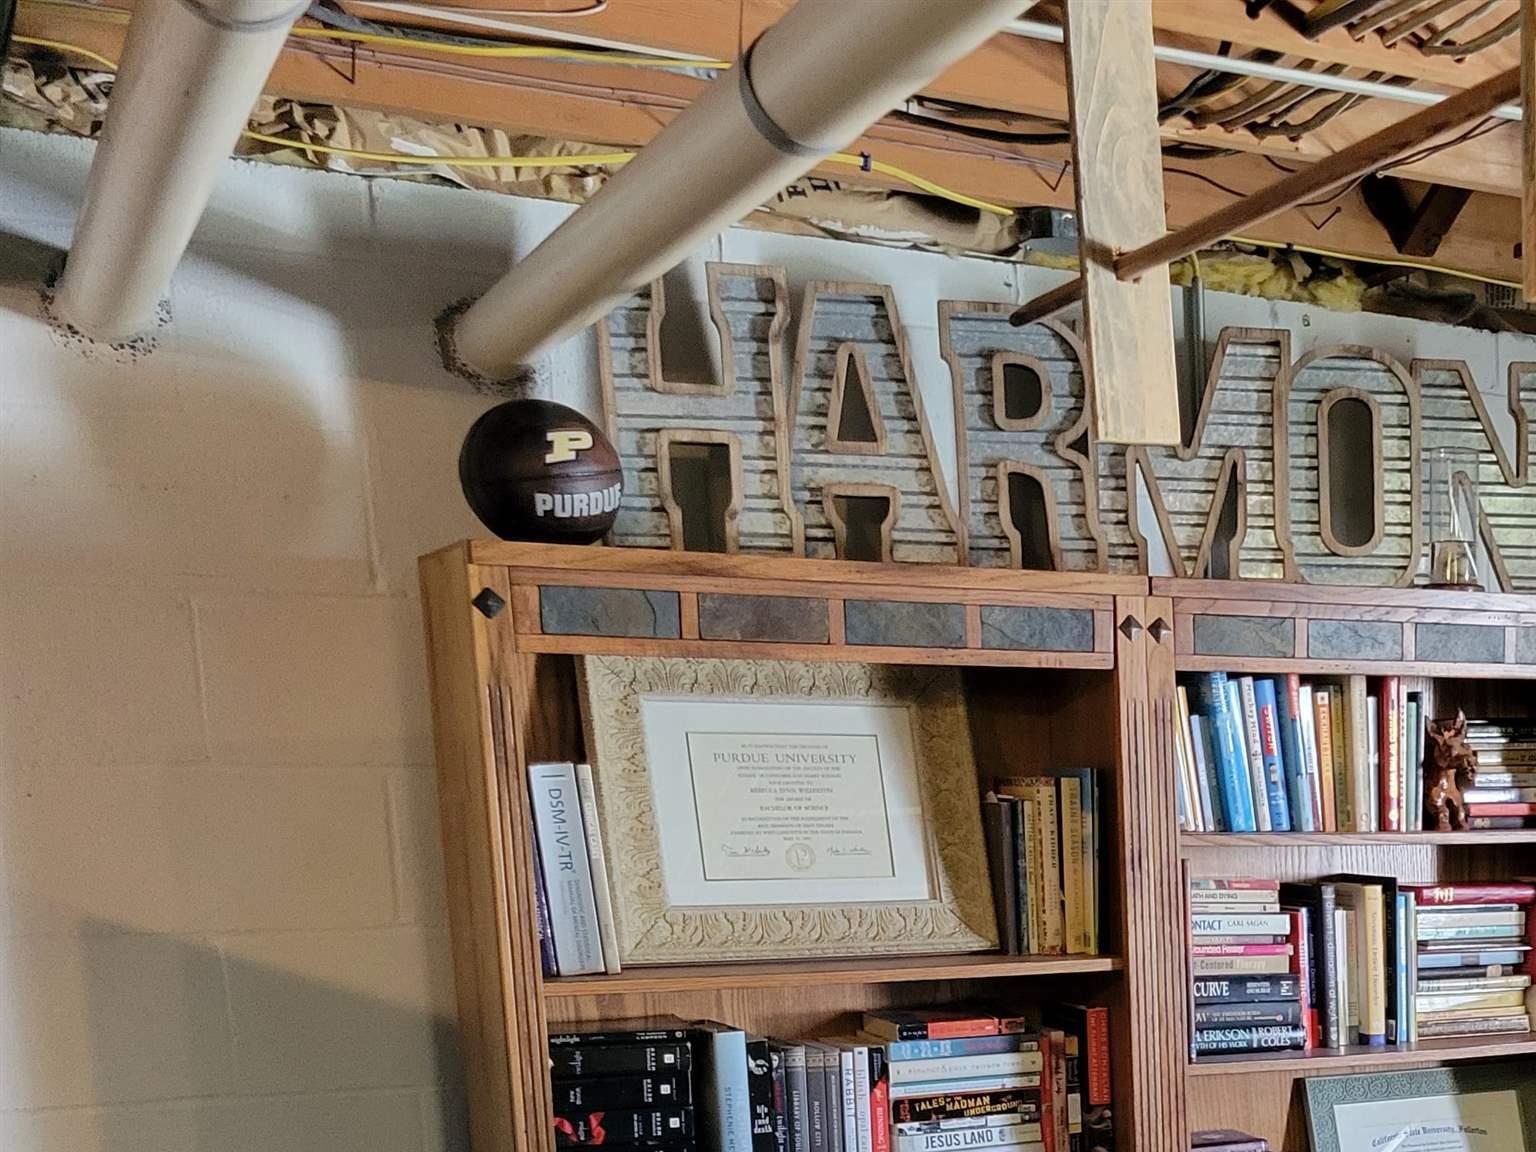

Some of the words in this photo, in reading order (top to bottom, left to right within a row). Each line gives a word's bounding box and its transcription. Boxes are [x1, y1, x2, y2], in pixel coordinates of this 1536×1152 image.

[544, 430, 593, 464] P
[534, 482, 621, 518] PURDUE
[713, 752, 770, 764] PURDUE
[775, 752, 857, 765] UNIVERSITY
[1192, 920, 1222, 930] NTACT
[1192, 946, 1221, 954] ounded
[1194, 982, 1230, 997] CURVE
[1204, 1029, 1250, 1041] ERIKSON
[1258, 1026, 1292, 1037] ROBERT
[1261, 1037, 1291, 1047] COLES
[845, 1068, 854, 1118] RABBIT
[914, 1096, 945, 1111] TALES
[946, 1096, 990, 1111] MADMAN
[774, 1115, 787, 1144] twilight
[924, 1133, 961, 1149] JESUS
[963, 1129, 993, 1145] LAND
